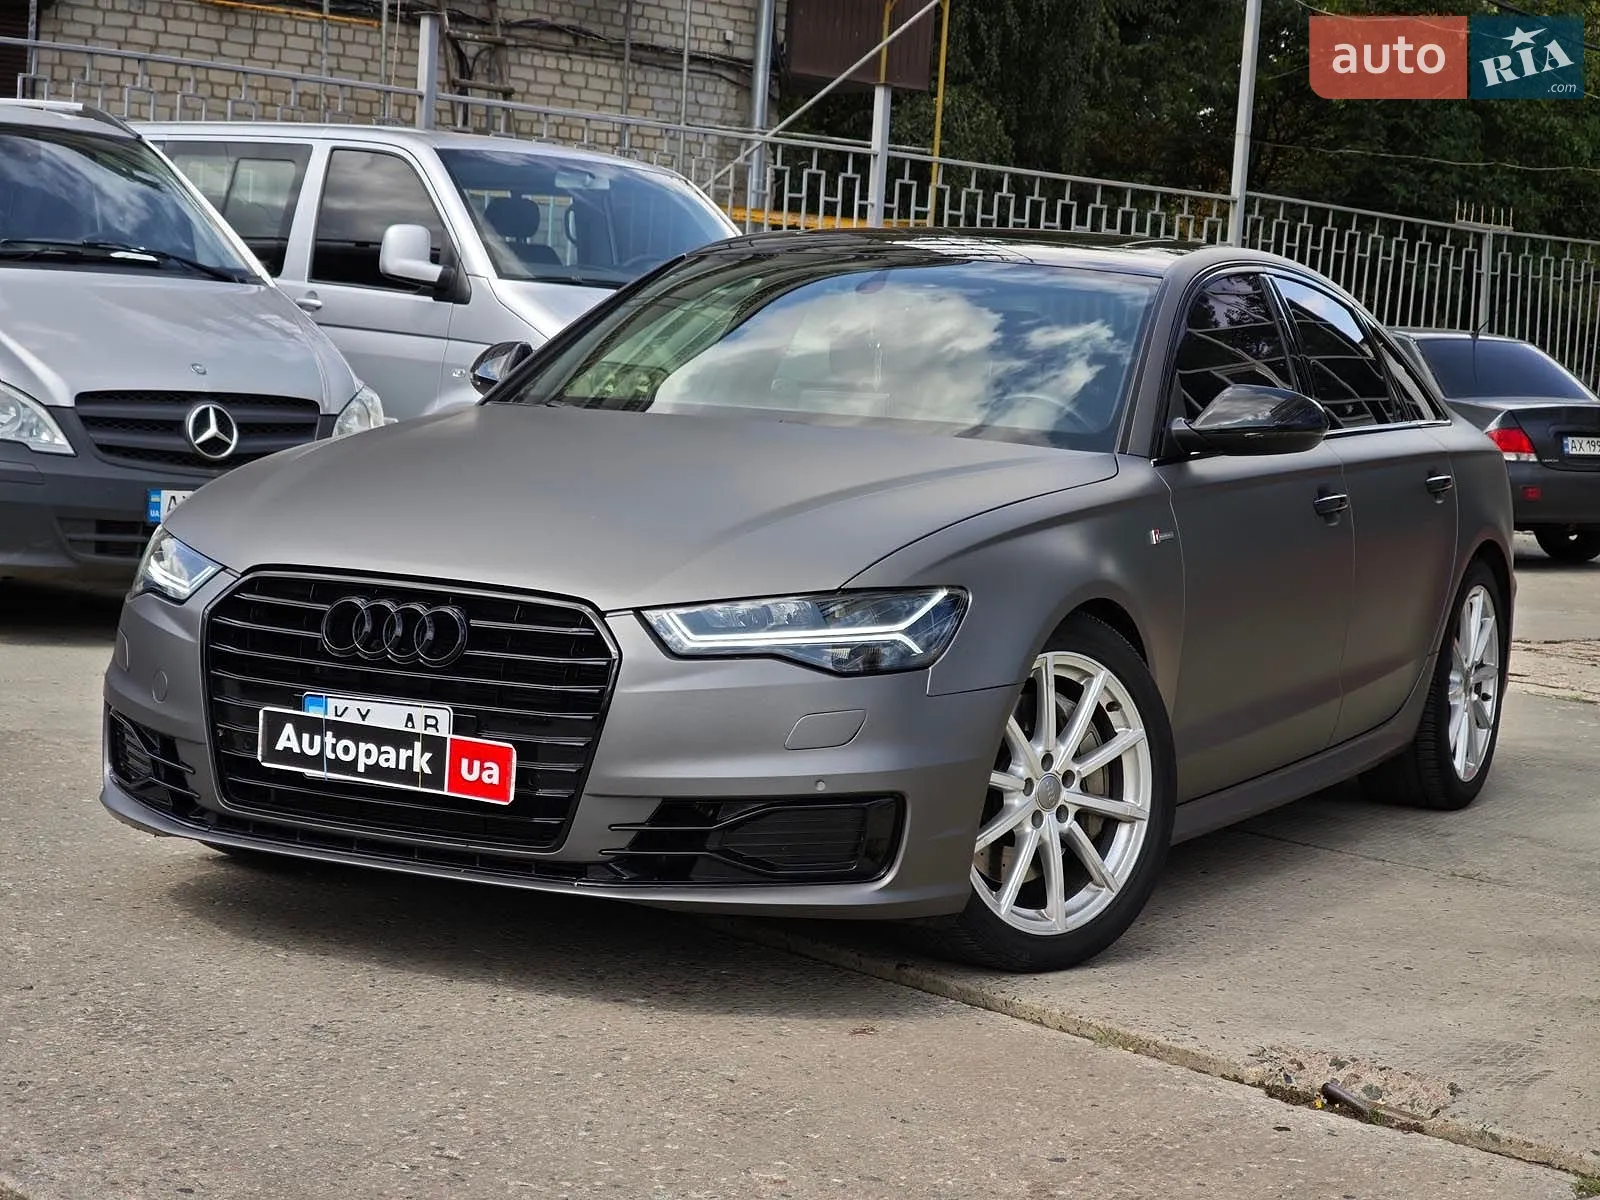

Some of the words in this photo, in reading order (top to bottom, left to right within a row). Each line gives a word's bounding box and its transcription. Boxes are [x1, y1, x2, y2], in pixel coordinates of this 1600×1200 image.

[1571, 439, 1585, 452] AX
[274, 722, 433, 775] Autopark
[460, 757, 500, 785] ua
